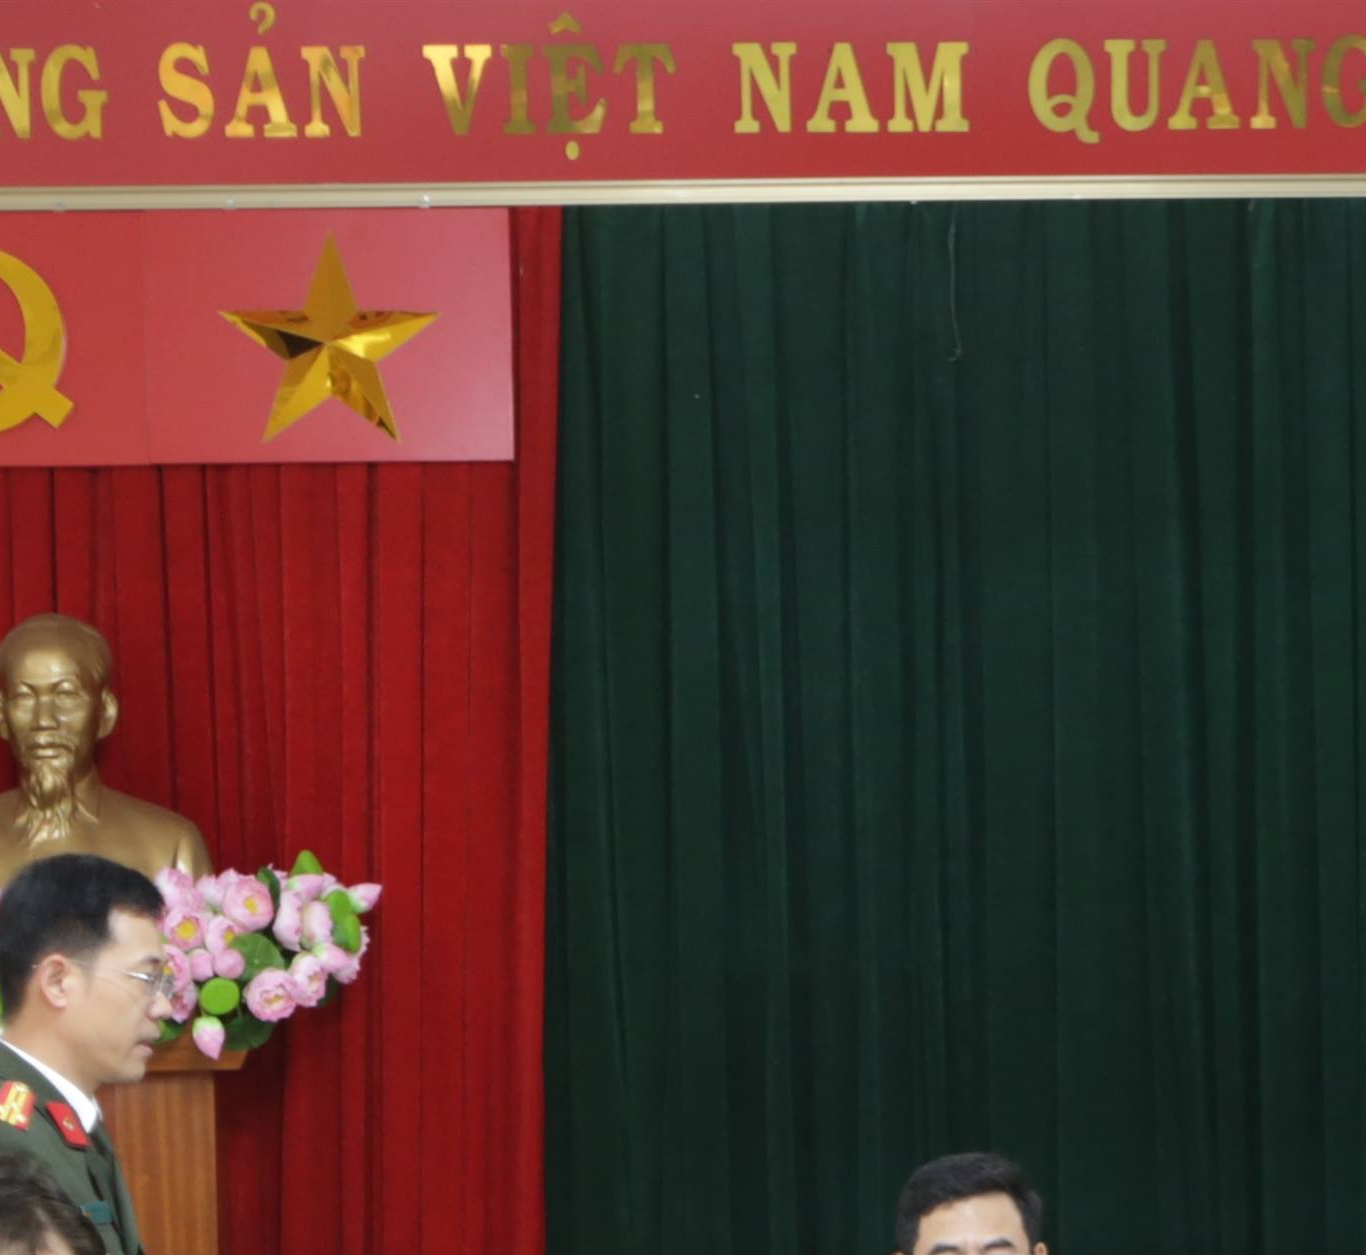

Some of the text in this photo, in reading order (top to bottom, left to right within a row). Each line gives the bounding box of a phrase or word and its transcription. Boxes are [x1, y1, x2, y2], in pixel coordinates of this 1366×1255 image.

[157, 1, 367, 139] SẢN
[421, 11, 677, 161] VIỆT
[731, 40, 970, 134] NAM
